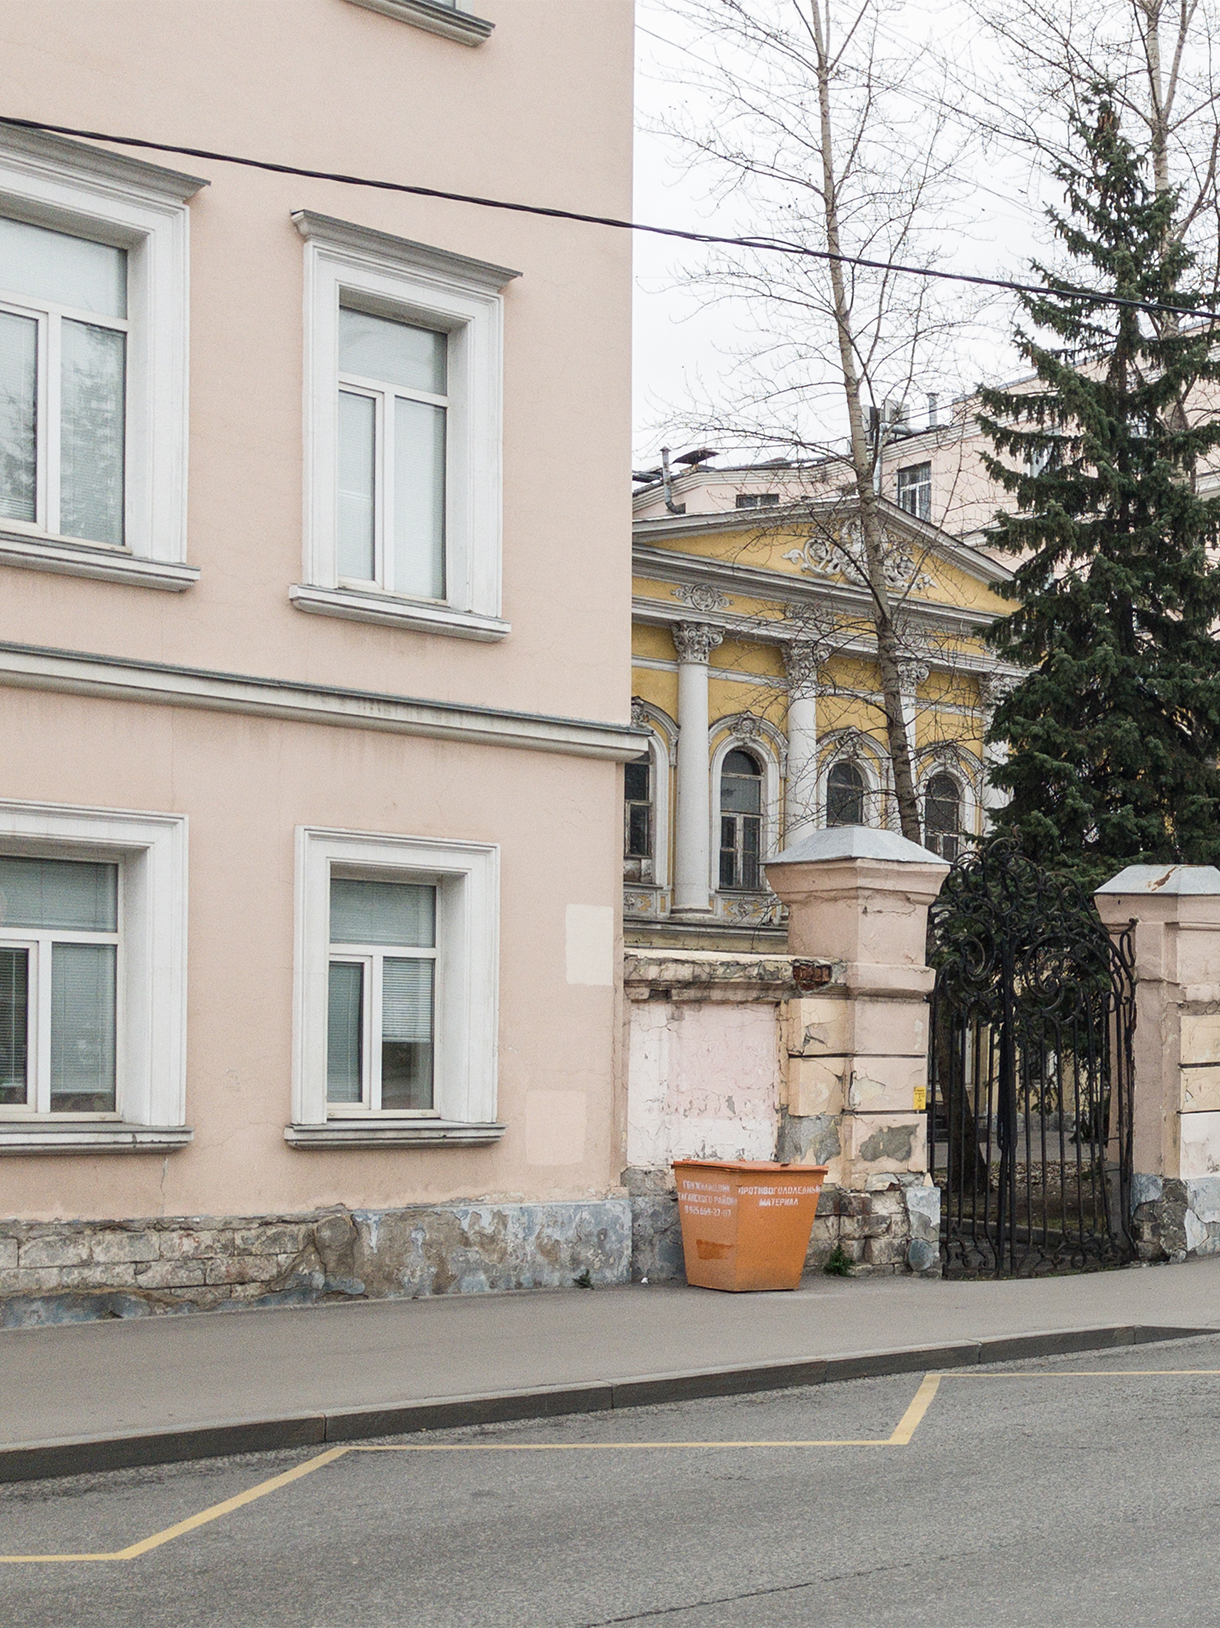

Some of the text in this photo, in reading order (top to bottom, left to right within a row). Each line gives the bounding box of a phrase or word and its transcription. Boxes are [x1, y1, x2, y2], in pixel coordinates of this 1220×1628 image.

[738, 1185, 821, 1195] ПРОТИВОГОЛОЛЕДНЫЙ
[678, 1192, 712, 1203] ТАГАНСКОГО
[758, 1198, 799, 1206] МАТЕРИАЛ
